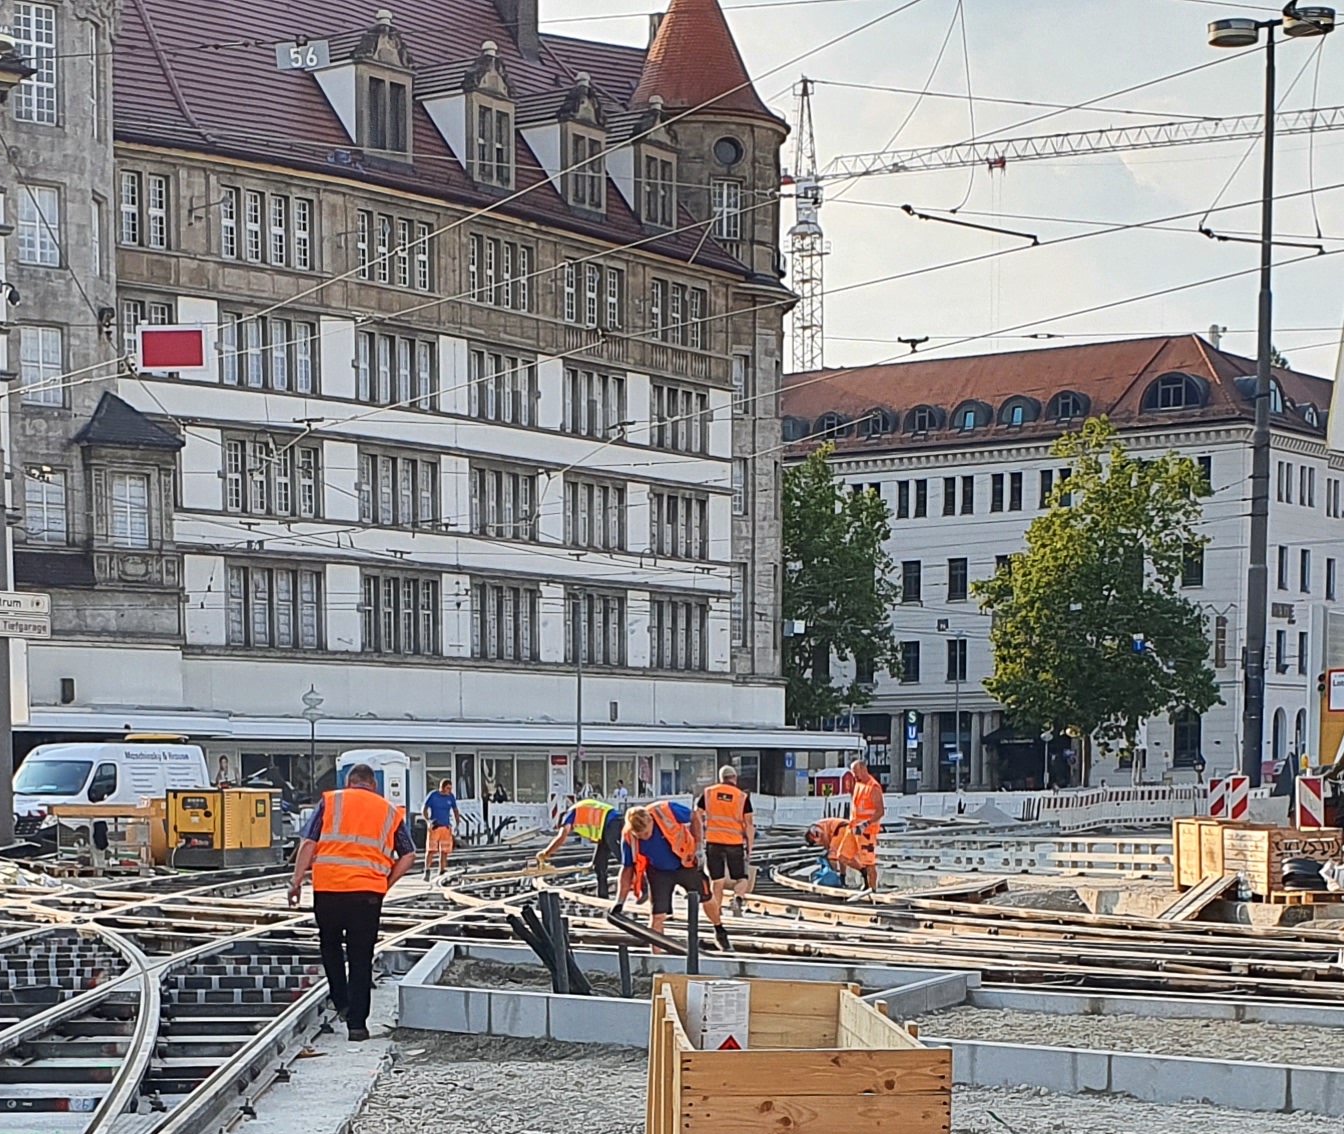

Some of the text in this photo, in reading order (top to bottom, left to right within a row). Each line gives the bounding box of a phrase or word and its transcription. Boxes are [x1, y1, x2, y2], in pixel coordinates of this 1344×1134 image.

[289, 46, 318, 68] 56
[3, 620, 47, 634] Tiefgarage
[908, 711, 916, 723] S
[908, 726, 917, 739] U
